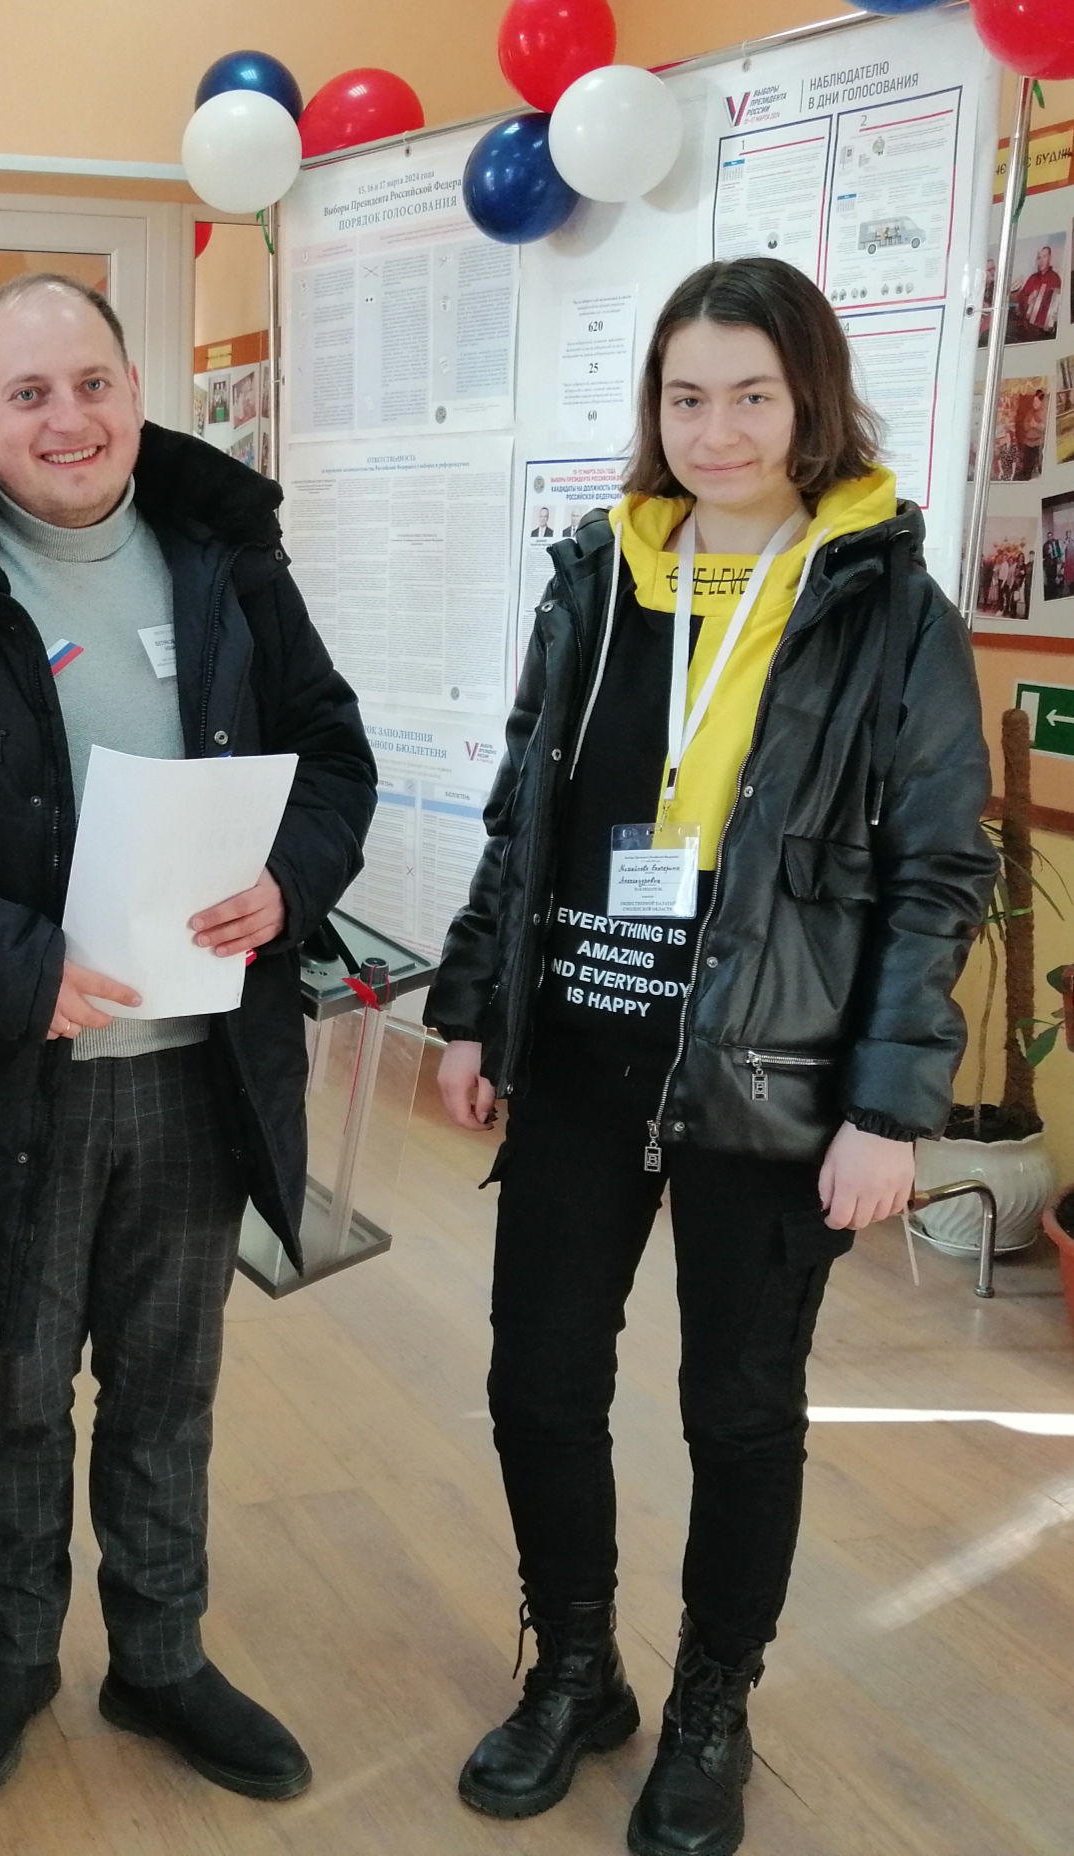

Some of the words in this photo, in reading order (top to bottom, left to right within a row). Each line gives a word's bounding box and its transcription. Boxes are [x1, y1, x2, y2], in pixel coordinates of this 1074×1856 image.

[810, 61, 889, 91] НАБЛЮДАТЕЛЮ
[750, 93, 787, 107] ПРЕЗИДЕНТА
[754, 85, 780, 97] ВЫБОРЫ
[808, 97, 814, 109] В
[817, 92, 839, 109] ДНИ
[843, 73, 919, 102] ГОЛОСОВАНИЯ
[747, 106, 770, 116] РОССИИ
[860, 115, 867, 126] 2
[368, 184, 373, 192] 16
[387, 178, 403, 188] марта
[405, 173, 419, 184] 2024
[421, 171, 434, 182] года
[324, 204, 349, 216] Выборы
[351, 195, 388, 212] Президента
[391, 183, 432, 201] Российской
[434, 179, 462, 190] Федера
[339, 212, 380, 230] ПОРЯДОК
[382, 196, 457, 220] ГОЛОСОВАНИЯ
[588, 321, 603, 332] 620
[589, 363, 598, 373] 25
[588, 410, 597, 421] 60
[378, 727, 433, 743] ЗАПОЛНЕНИЯ
[396, 743, 447, 759] БЮЛЛЕТЕНЯ
[557, 907, 663, 942] EVERYTHING
[667, 928, 687, 945] IS
[577, 940, 654, 969] AMAZING
[551, 958, 575, 978] ND
[579, 965, 691, 998] EVERYBODY
[567, 987, 584, 1004] IS
[588, 992, 651, 1017] HAPPY
